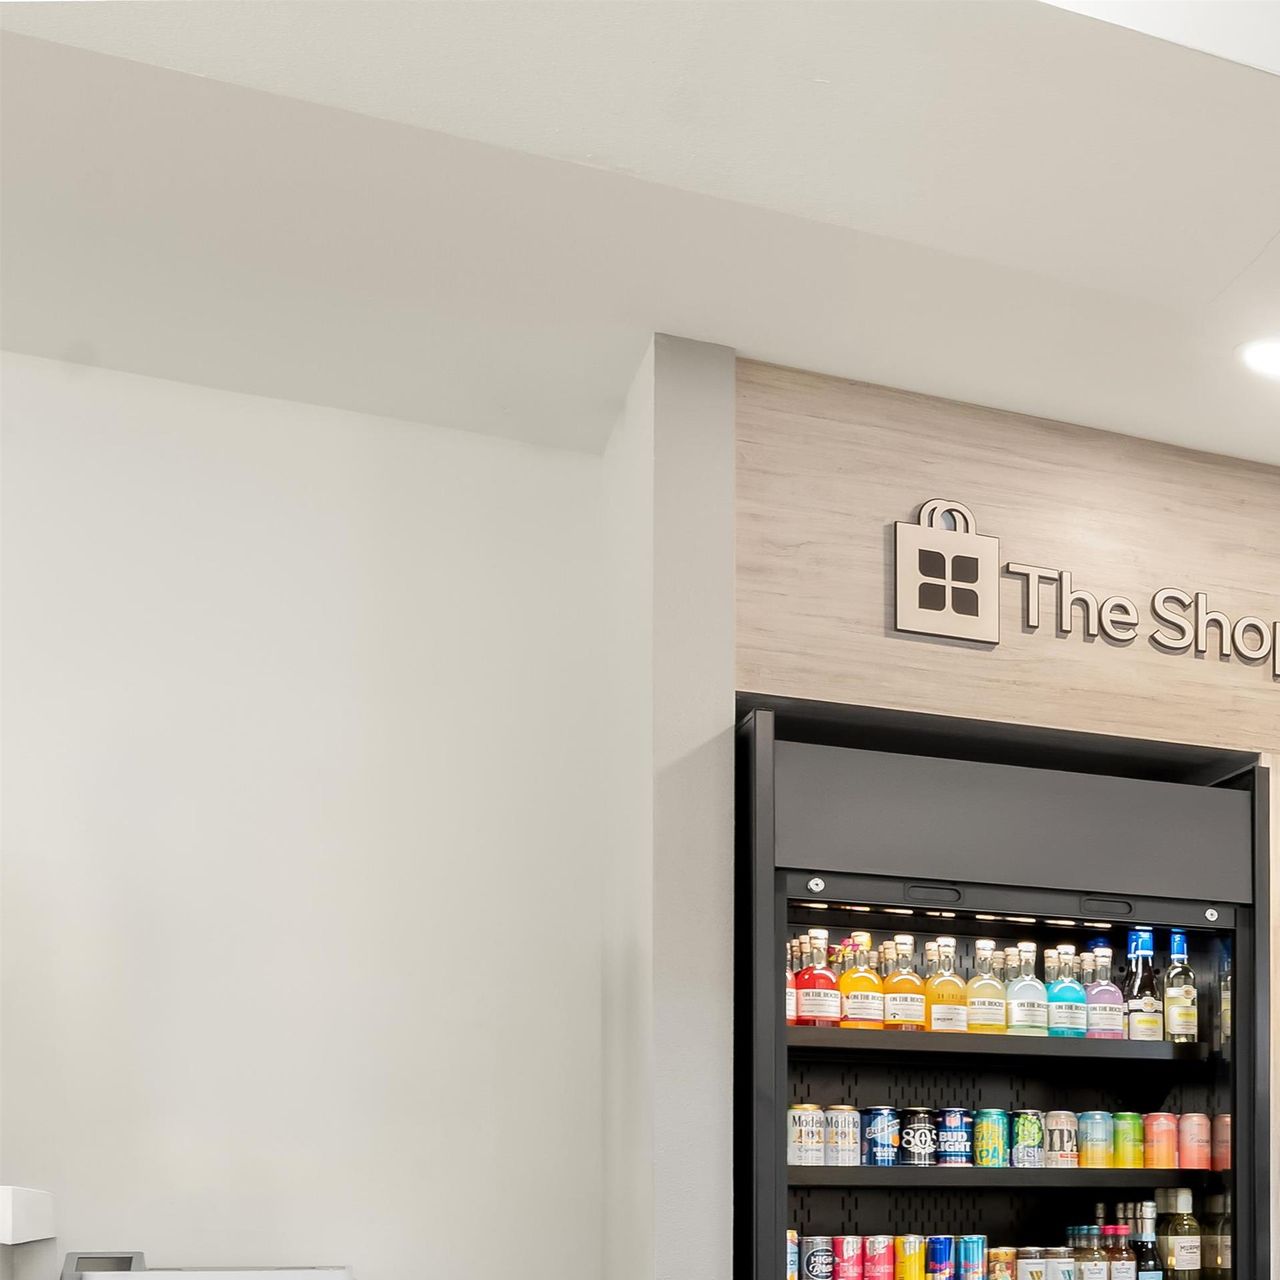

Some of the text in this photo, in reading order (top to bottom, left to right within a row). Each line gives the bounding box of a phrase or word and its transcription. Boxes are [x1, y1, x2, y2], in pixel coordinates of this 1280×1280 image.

[1006, 562, 1140, 642] The
[825, 1116, 858, 1129] Modelo
[939, 1132, 968, 1142] BUD
